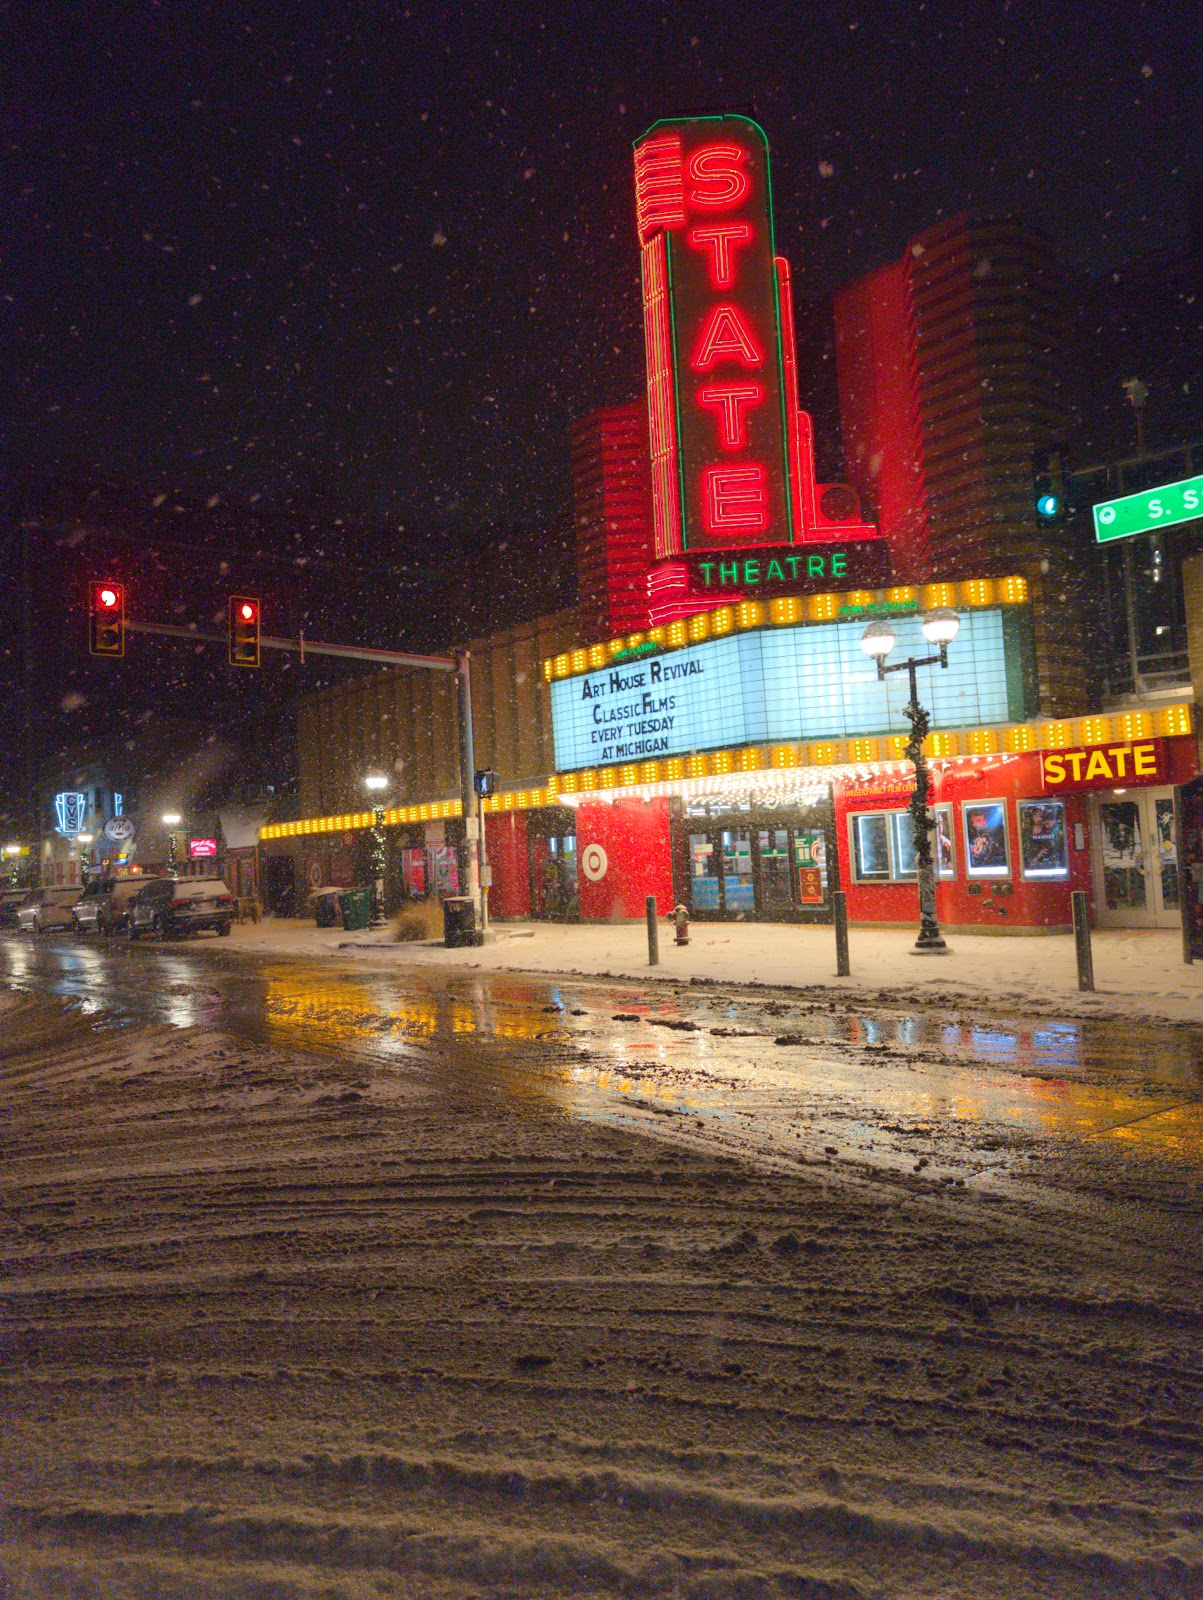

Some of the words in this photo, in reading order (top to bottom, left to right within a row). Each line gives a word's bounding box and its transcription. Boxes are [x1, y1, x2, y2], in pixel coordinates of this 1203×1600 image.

[690, 146, 763, 529] STATE
[1148, 499, 1172, 518] S.
[1183, 489, 1203, 509] S
[700, 553, 847, 586] THEATRE
[839, 605, 863, 615] NOW
[867, 600, 917, 613] PLAYING
[582, 679, 606, 700] ART
[609, 671, 646, 694] HOUSE
[650, 659, 704, 684] REVIVAL
[593, 703, 640, 725] CLASSIC
[642, 691, 676, 715] FILMS
[591, 725, 623, 744] EVERY
[627, 715, 676, 737] TUESDAY
[602, 745, 615, 760] AT
[616, 736, 669, 758] MICHIGAN
[1044, 744, 1157, 784] STATE
[66, 795, 77, 830] CVS
